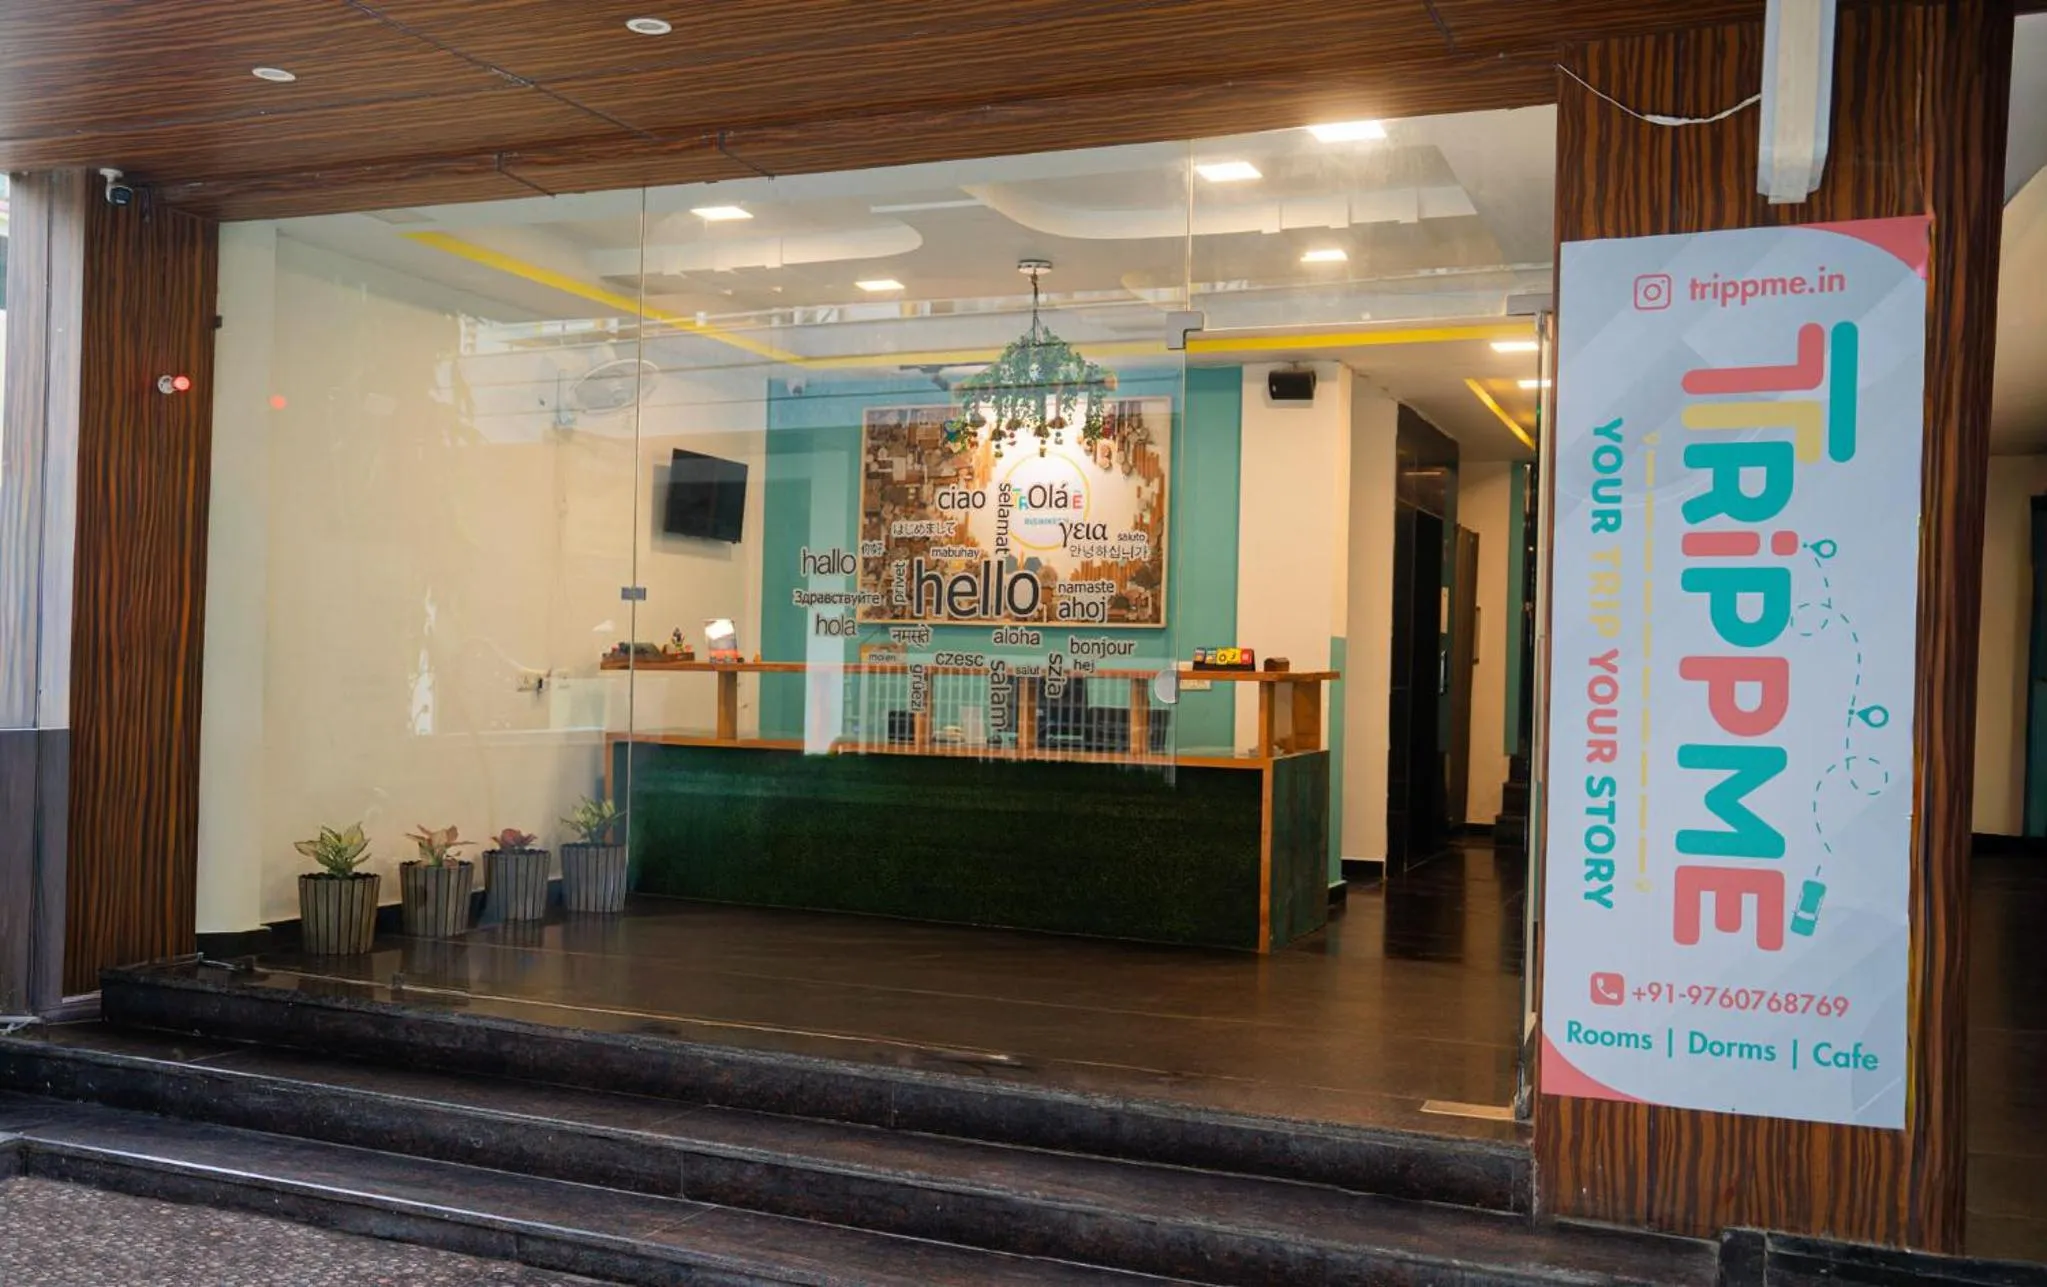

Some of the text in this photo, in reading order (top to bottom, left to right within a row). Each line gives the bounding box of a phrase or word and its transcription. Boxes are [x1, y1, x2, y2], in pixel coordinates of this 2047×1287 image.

[1689, 266, 1846, 307] trippme.in
[938, 486, 986, 510] ciao
[1027, 483, 1069, 509] Olá
[995, 482, 1014, 555] selamat
[1059, 522, 1109, 548] γεια
[802, 548, 857, 575] hallo
[930, 546, 980, 559] mabuhay
[894, 562, 906, 604] privet
[914, 560, 1040, 617] hello
[1057, 581, 1115, 594] namaste
[1058, 595, 1107, 623] ahoj
[815, 613, 857, 637] hola
[993, 629, 1041, 645] aloha
[935, 653, 984, 667] czesc
[1070, 637, 1135, 657] bonjour
[1015, 665, 1040, 676] salut
[1047, 653, 1066, 697] szia
[1073, 659, 1095, 673] hej
[1583, 417, 1624, 910] YOUR TRIP YOUR STORY
[990, 660, 1010, 729] salam
[1632, 982, 1850, 1018] +91-9760768769
[1566, 1020, 1653, 1051] Rooms
[1688, 1032, 1777, 1063] Dorms
[1812, 1042, 1880, 1073] Cafe
